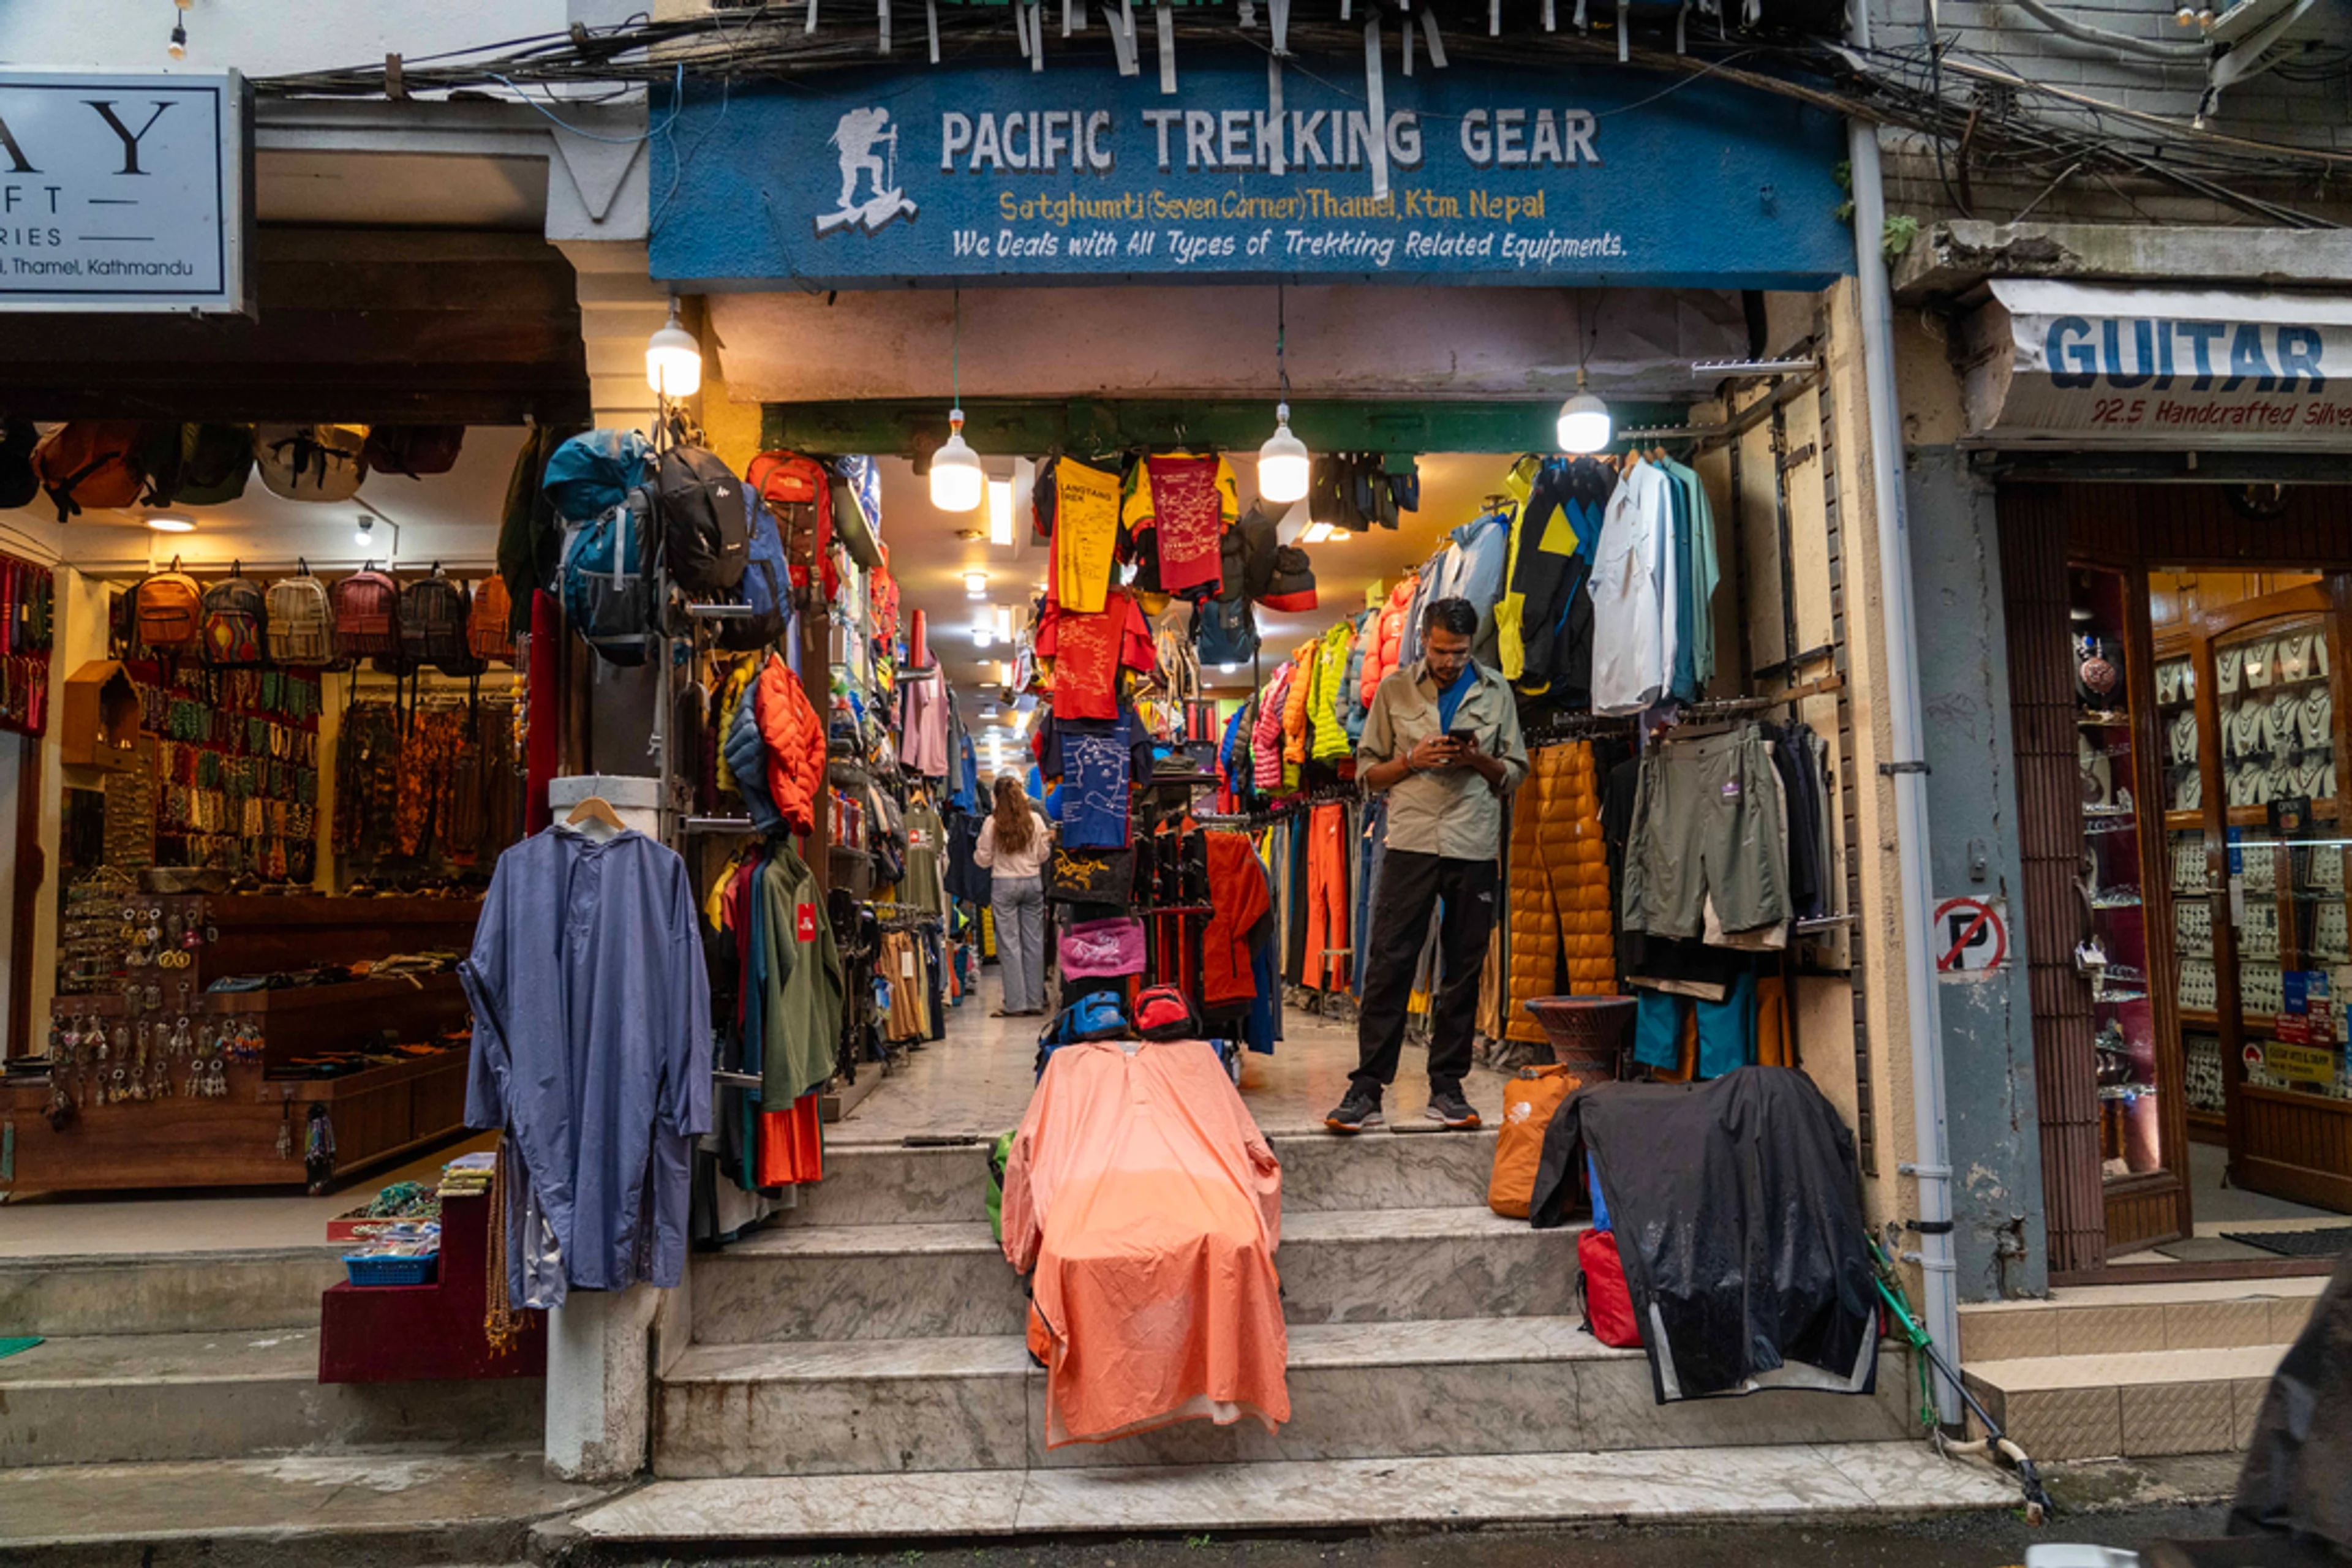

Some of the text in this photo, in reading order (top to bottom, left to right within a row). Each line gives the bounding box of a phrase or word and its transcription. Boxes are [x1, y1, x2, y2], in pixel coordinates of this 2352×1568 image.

[940, 110, 1115, 173] PACIFIC
[1460, 108, 1602, 168] GEAR
[1469, 189, 1545, 225] Nepal
[88, 258, 194, 276] Kathmandu
[952, 228, 1627, 268] We Deals with All Types of Trekking Related Equipments.
[2046, 315, 2327, 394] GUITAR
[2090, 398, 2352, 427] 92.5 Handcrafted Silve
